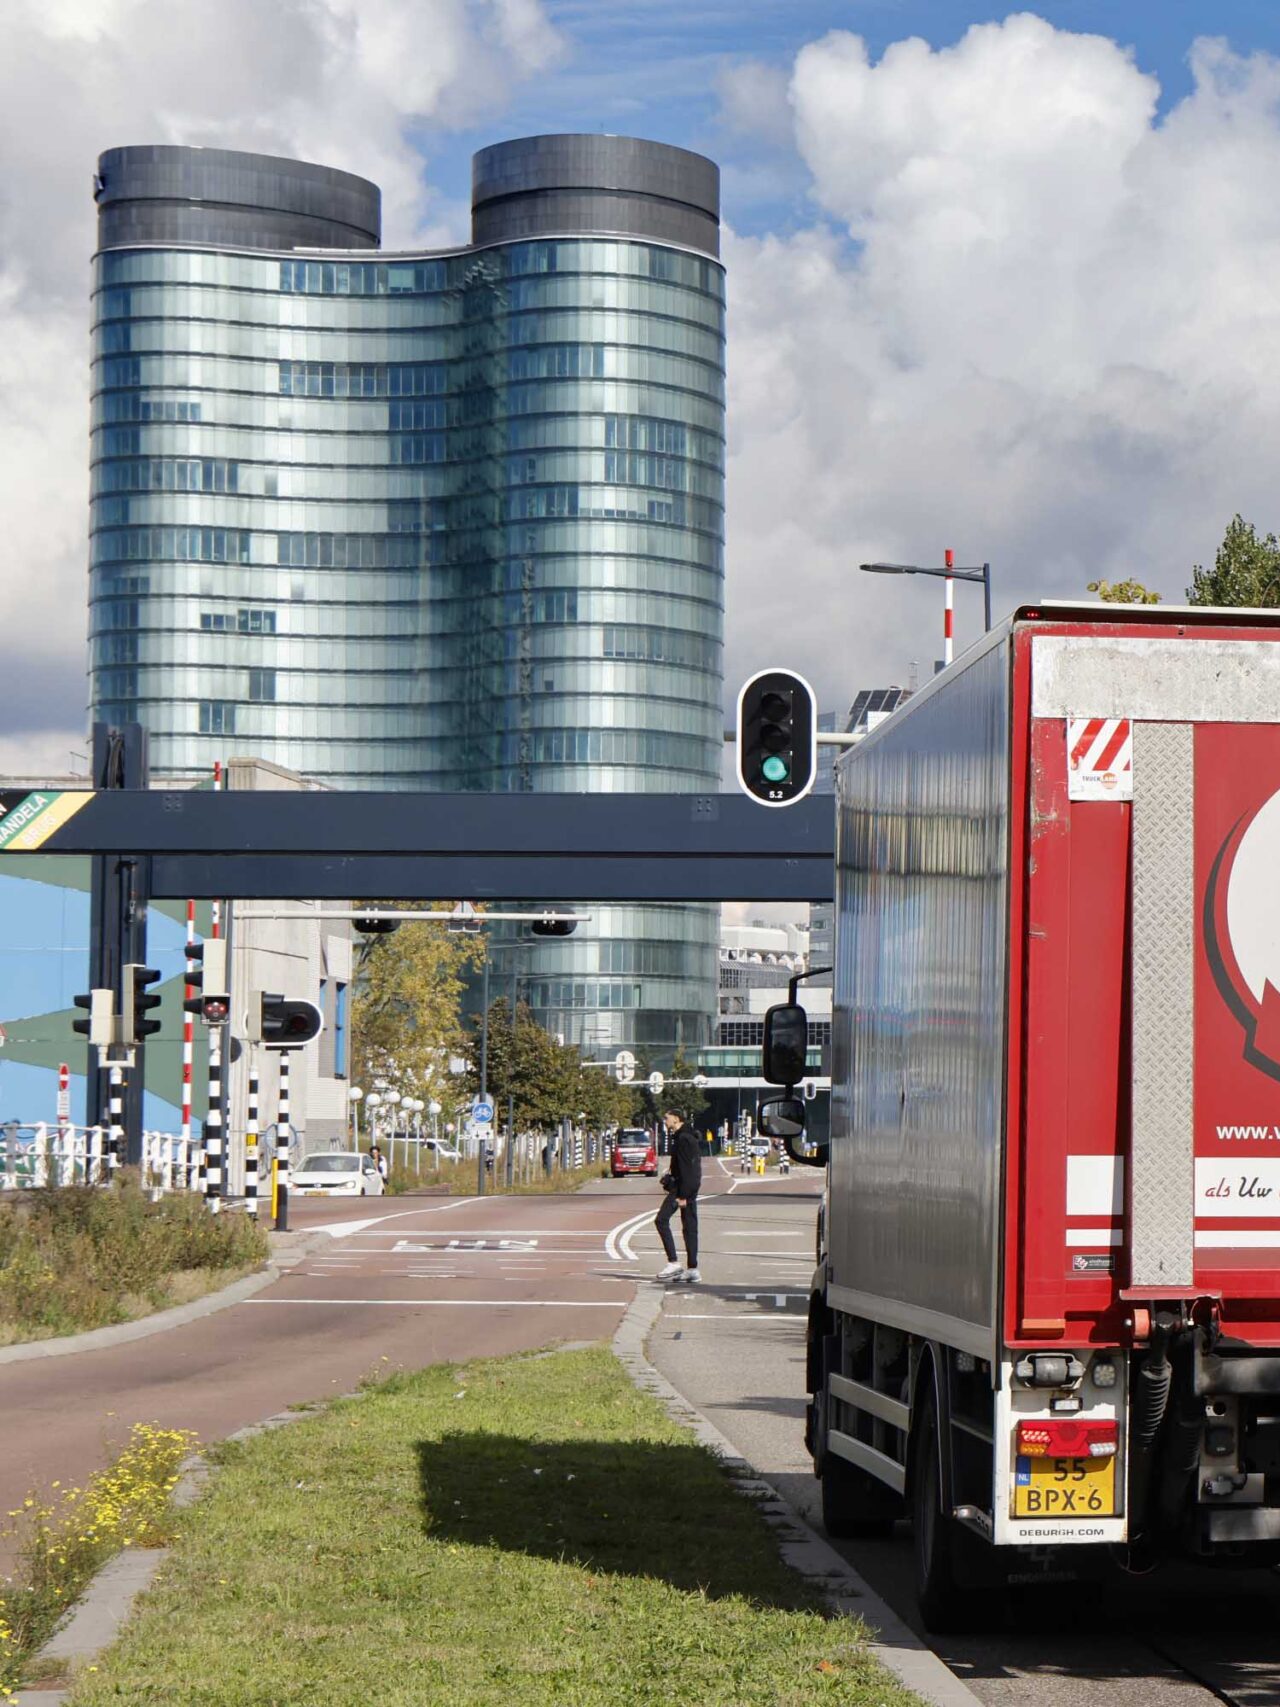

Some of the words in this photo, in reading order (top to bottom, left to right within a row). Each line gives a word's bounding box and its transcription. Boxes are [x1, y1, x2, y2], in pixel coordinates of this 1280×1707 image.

[769, 790, 784, 799] 5.2
[1204, 1177, 1231, 1197] als
[1238, 1176, 1272, 1198] Uw
[1018, 1473, 1029, 1482] NL
[1053, 1458, 1086, 1482] 55
[1027, 1489, 1103, 1512] BPX-6
[1019, 1528, 1105, 1537] DEBURGH.COM
